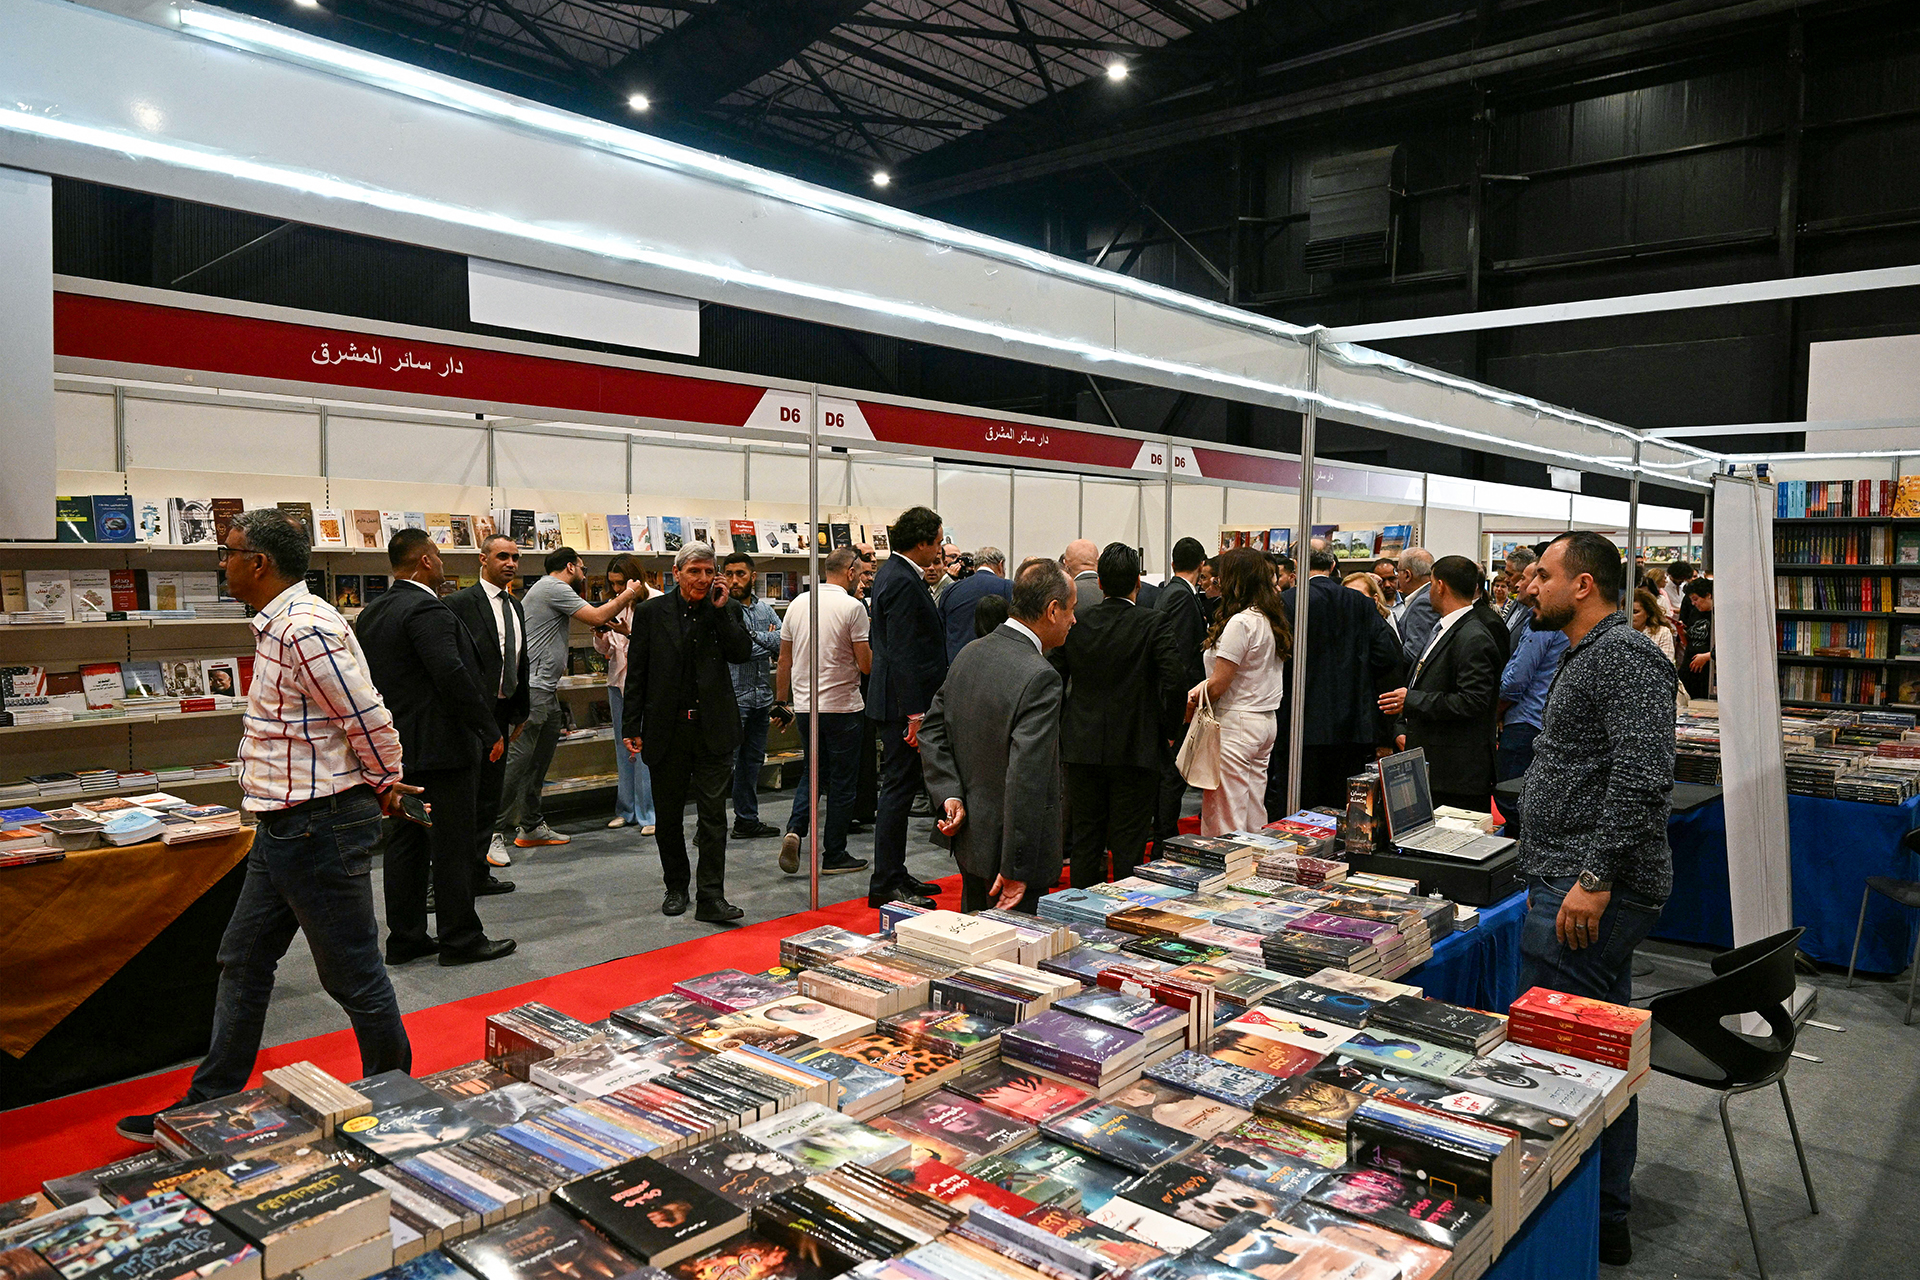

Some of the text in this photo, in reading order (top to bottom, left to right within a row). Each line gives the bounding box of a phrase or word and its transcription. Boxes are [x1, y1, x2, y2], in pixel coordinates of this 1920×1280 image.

[312, 343, 463, 377] دار سائر المشرق
[780, 406, 801, 423] D6
[825, 411, 845, 428] D6
[985, 427, 1049, 446] دار سائر المشرق
[1151, 453, 1163, 466] D6
[1174, 456, 1186, 468] D6
